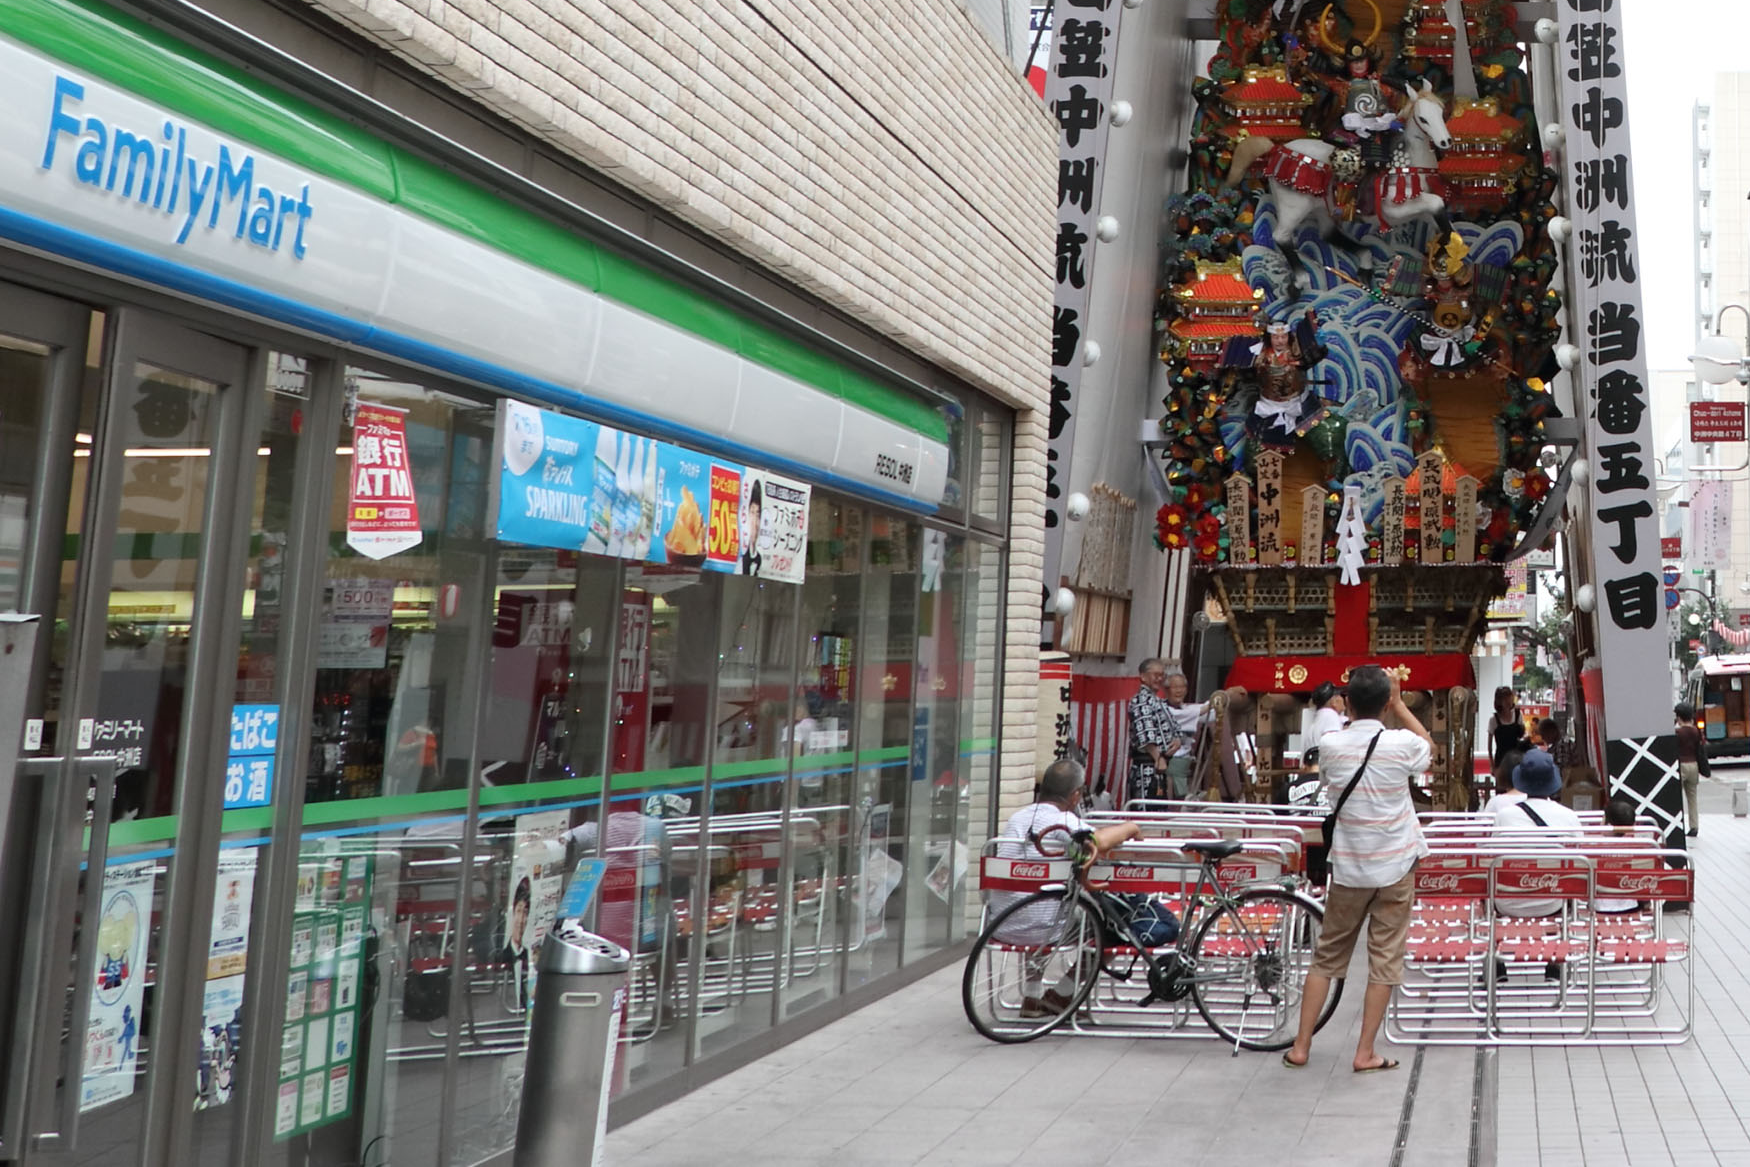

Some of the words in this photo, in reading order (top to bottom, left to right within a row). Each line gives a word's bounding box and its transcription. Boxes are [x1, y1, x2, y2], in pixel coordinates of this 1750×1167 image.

[42, 75, 314, 262] FamilyMart
[357, 435, 402, 467] 銀行
[356, 468, 410, 497] ATM
[525, 485, 589, 527] SPARKLING
[1259, 483, 1281, 553] 中洲流
[232, 709, 278, 750] たばこ
[224, 764, 269, 802] お酒
[1012, 865, 1048, 878] Coca-Cola
[1116, 866, 1152, 879] Coca-Cola
[1219, 867, 1256, 881] Coca-Cola
[1419, 873, 1459, 889] Coca-Cola
[1520, 873, 1559, 889] Coca-Cola
[1619, 874, 1659, 890] Coca-Cola
